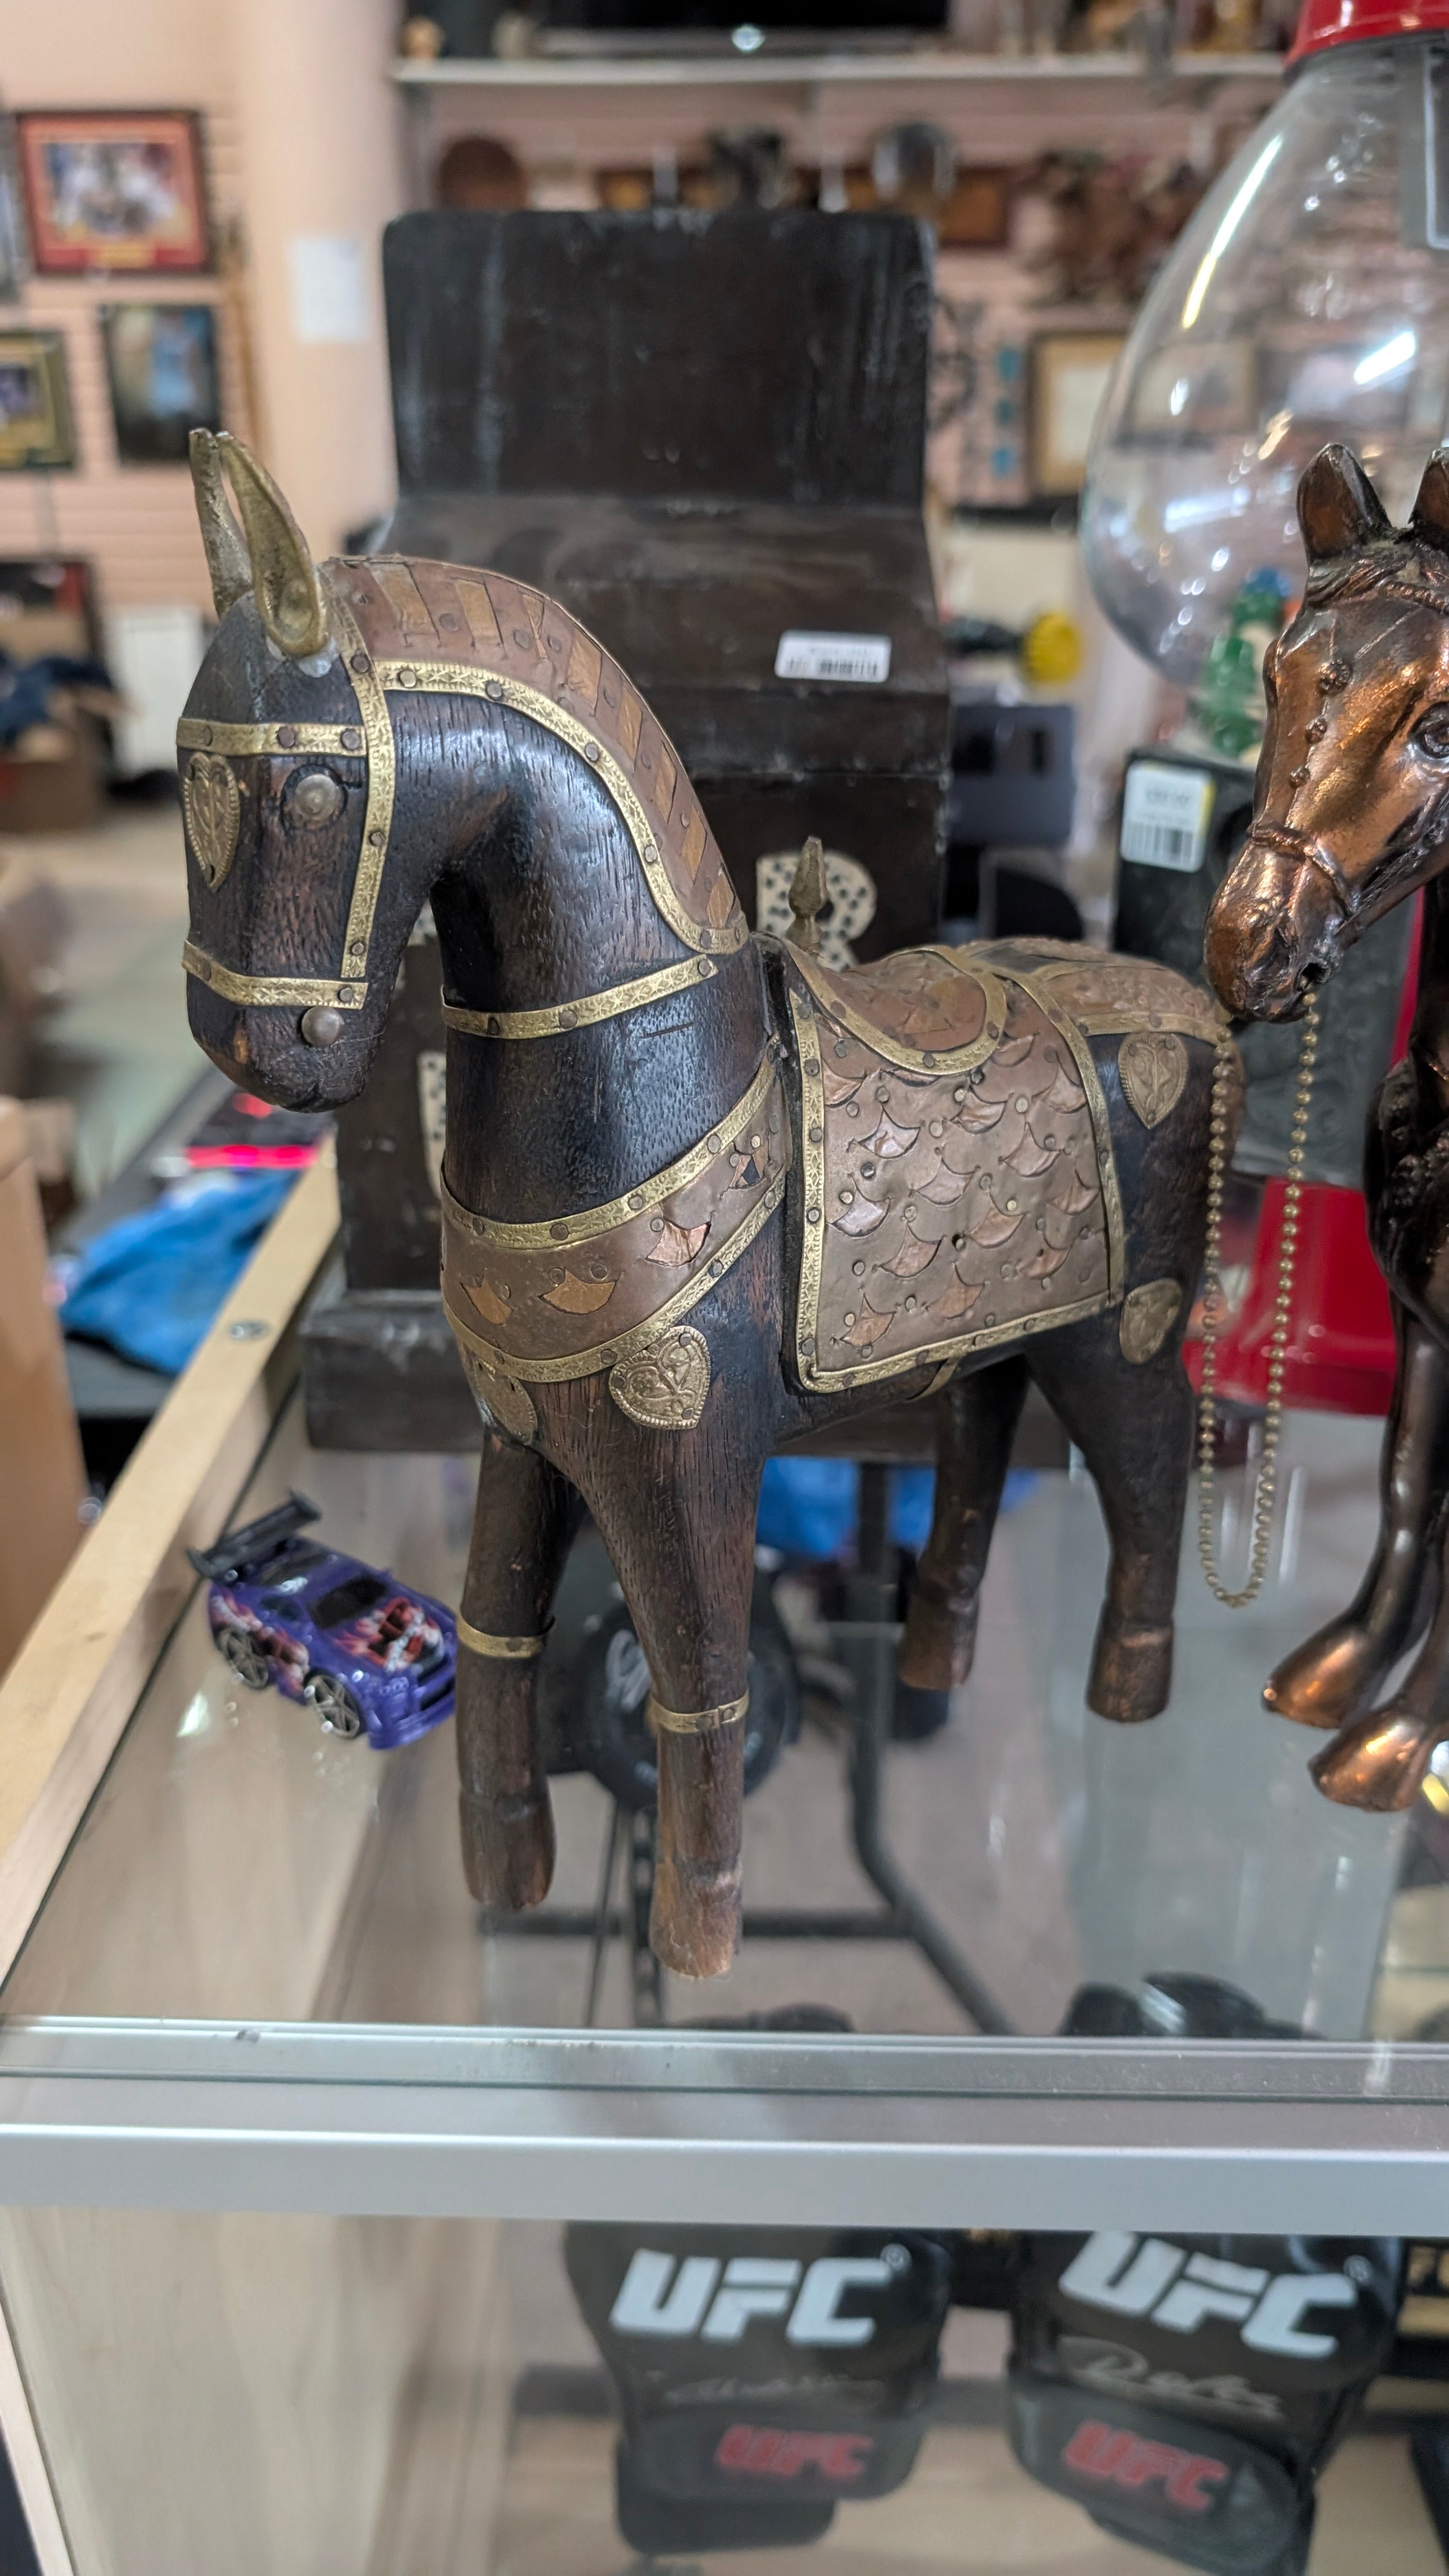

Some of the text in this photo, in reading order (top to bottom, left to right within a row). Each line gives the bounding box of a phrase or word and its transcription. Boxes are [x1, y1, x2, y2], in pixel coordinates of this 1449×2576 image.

[610, 2249, 893, 2345] UFC
[1059, 2232, 1357, 2359] UFC
[714, 2425, 873, 2478] UFC
[1062, 2420, 1230, 2510] UFC
